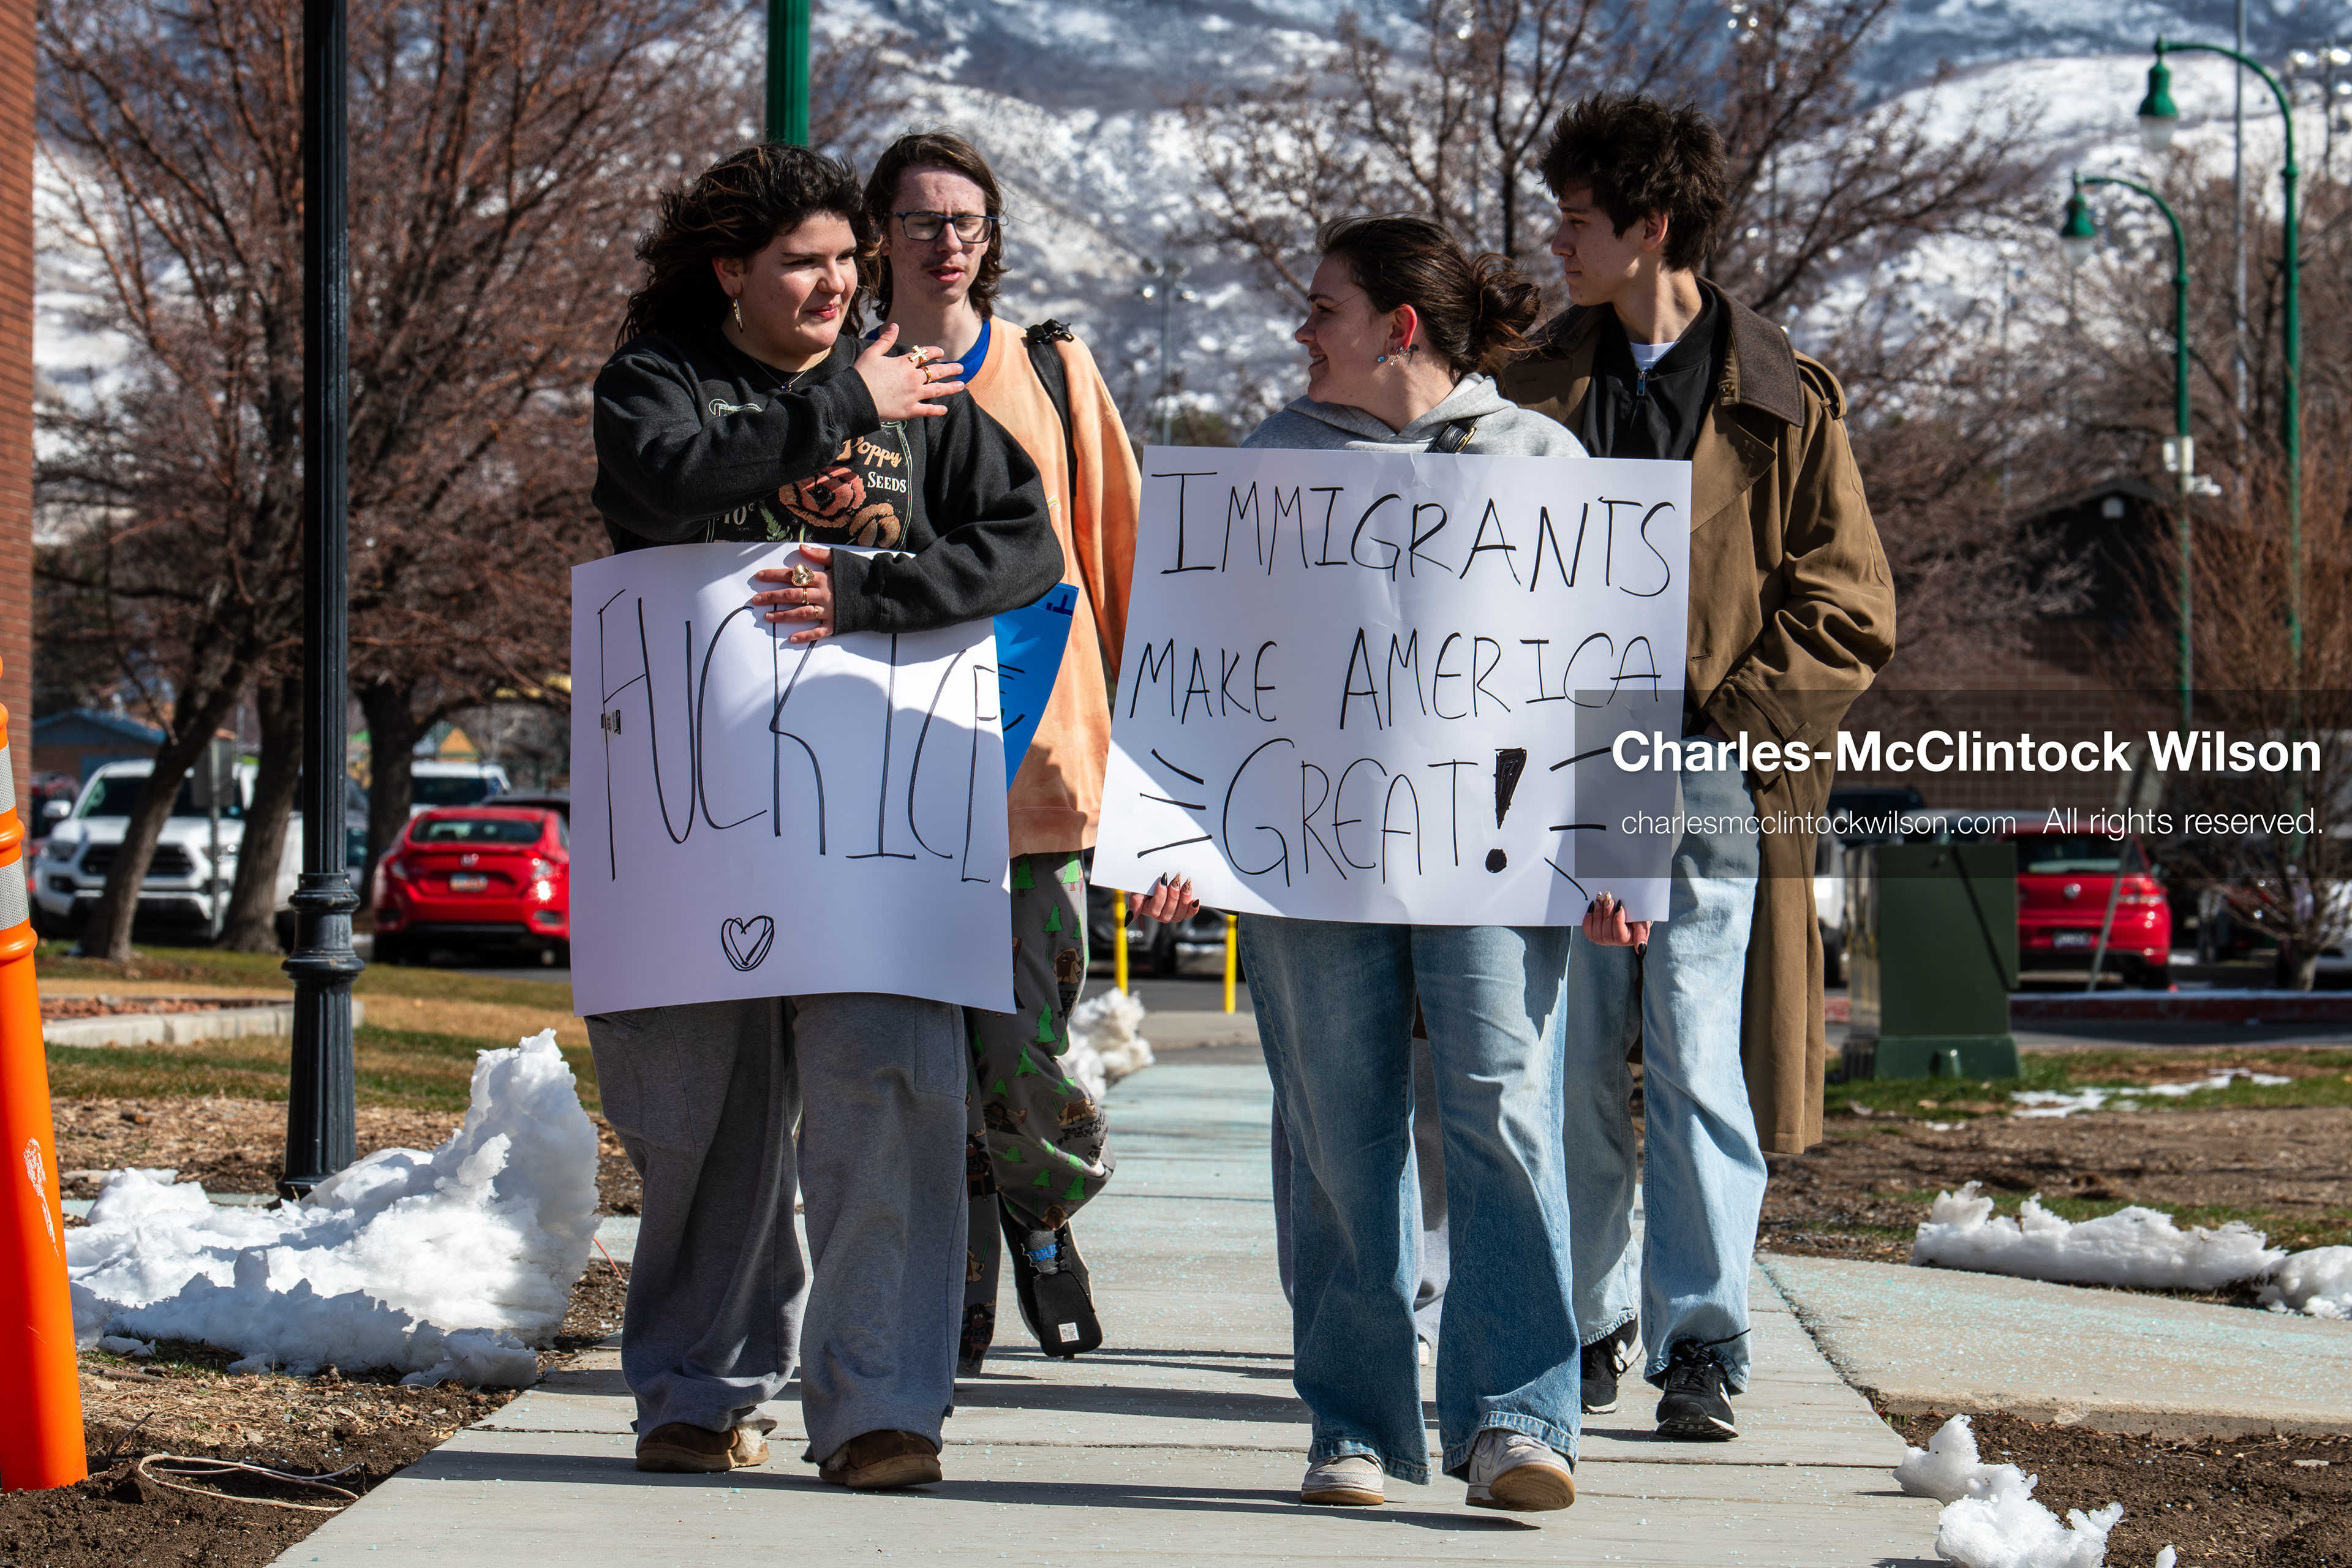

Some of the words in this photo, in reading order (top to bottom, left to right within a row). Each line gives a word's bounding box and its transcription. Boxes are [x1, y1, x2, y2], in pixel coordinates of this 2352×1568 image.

[836, 435, 902, 468] Poppy
[1151, 472, 1675, 597] IMMIGRANTS
[597, 589, 826, 882] FUCK
[845, 633, 997, 883] ICE
[1129, 638, 1278, 725] MAKE
[1340, 627, 1662, 731] AMERICA
[1222, 737, 1528, 888] GREAT!
